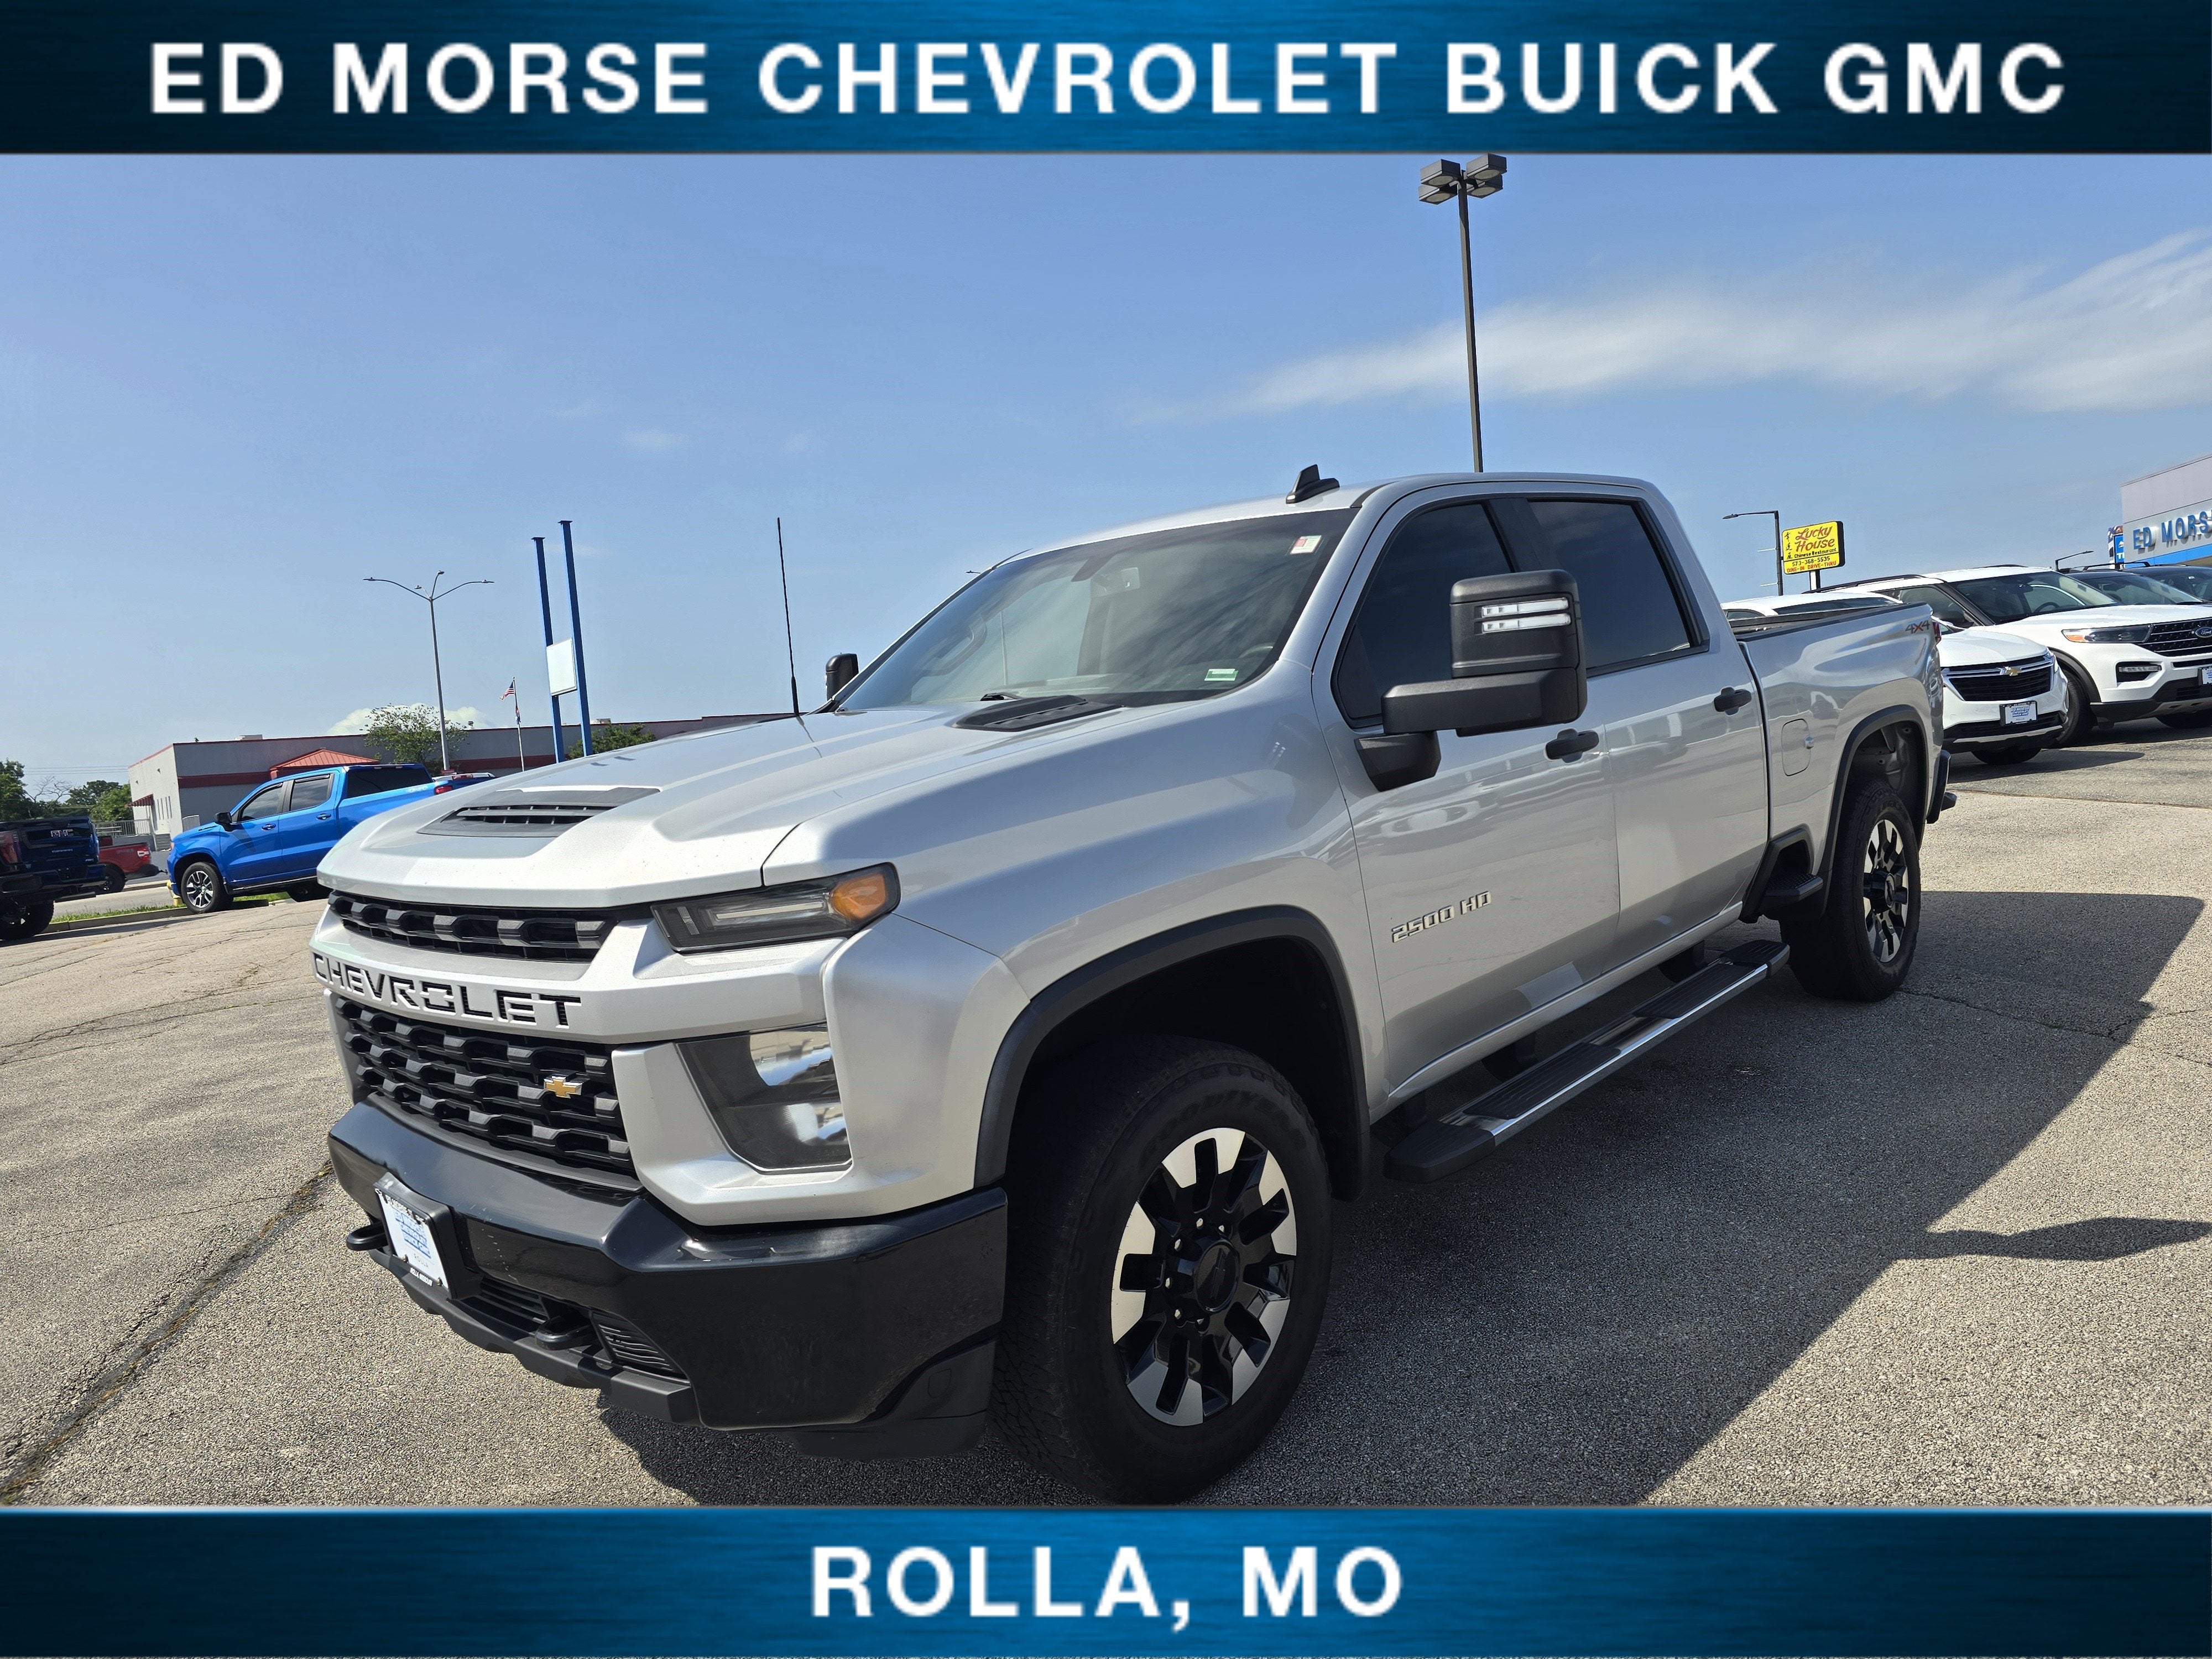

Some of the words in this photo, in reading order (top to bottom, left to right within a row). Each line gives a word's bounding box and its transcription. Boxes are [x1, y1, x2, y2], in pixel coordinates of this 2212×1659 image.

[1795, 526, 1833, 540] Lucky
[2133, 527, 2152, 550] ED
[2161, 509, 2212, 542] MORS
[1391, 905, 1455, 943] 2500
[1460, 890, 1491, 915] HD
[311, 951, 582, 1029] CHEVROLET
